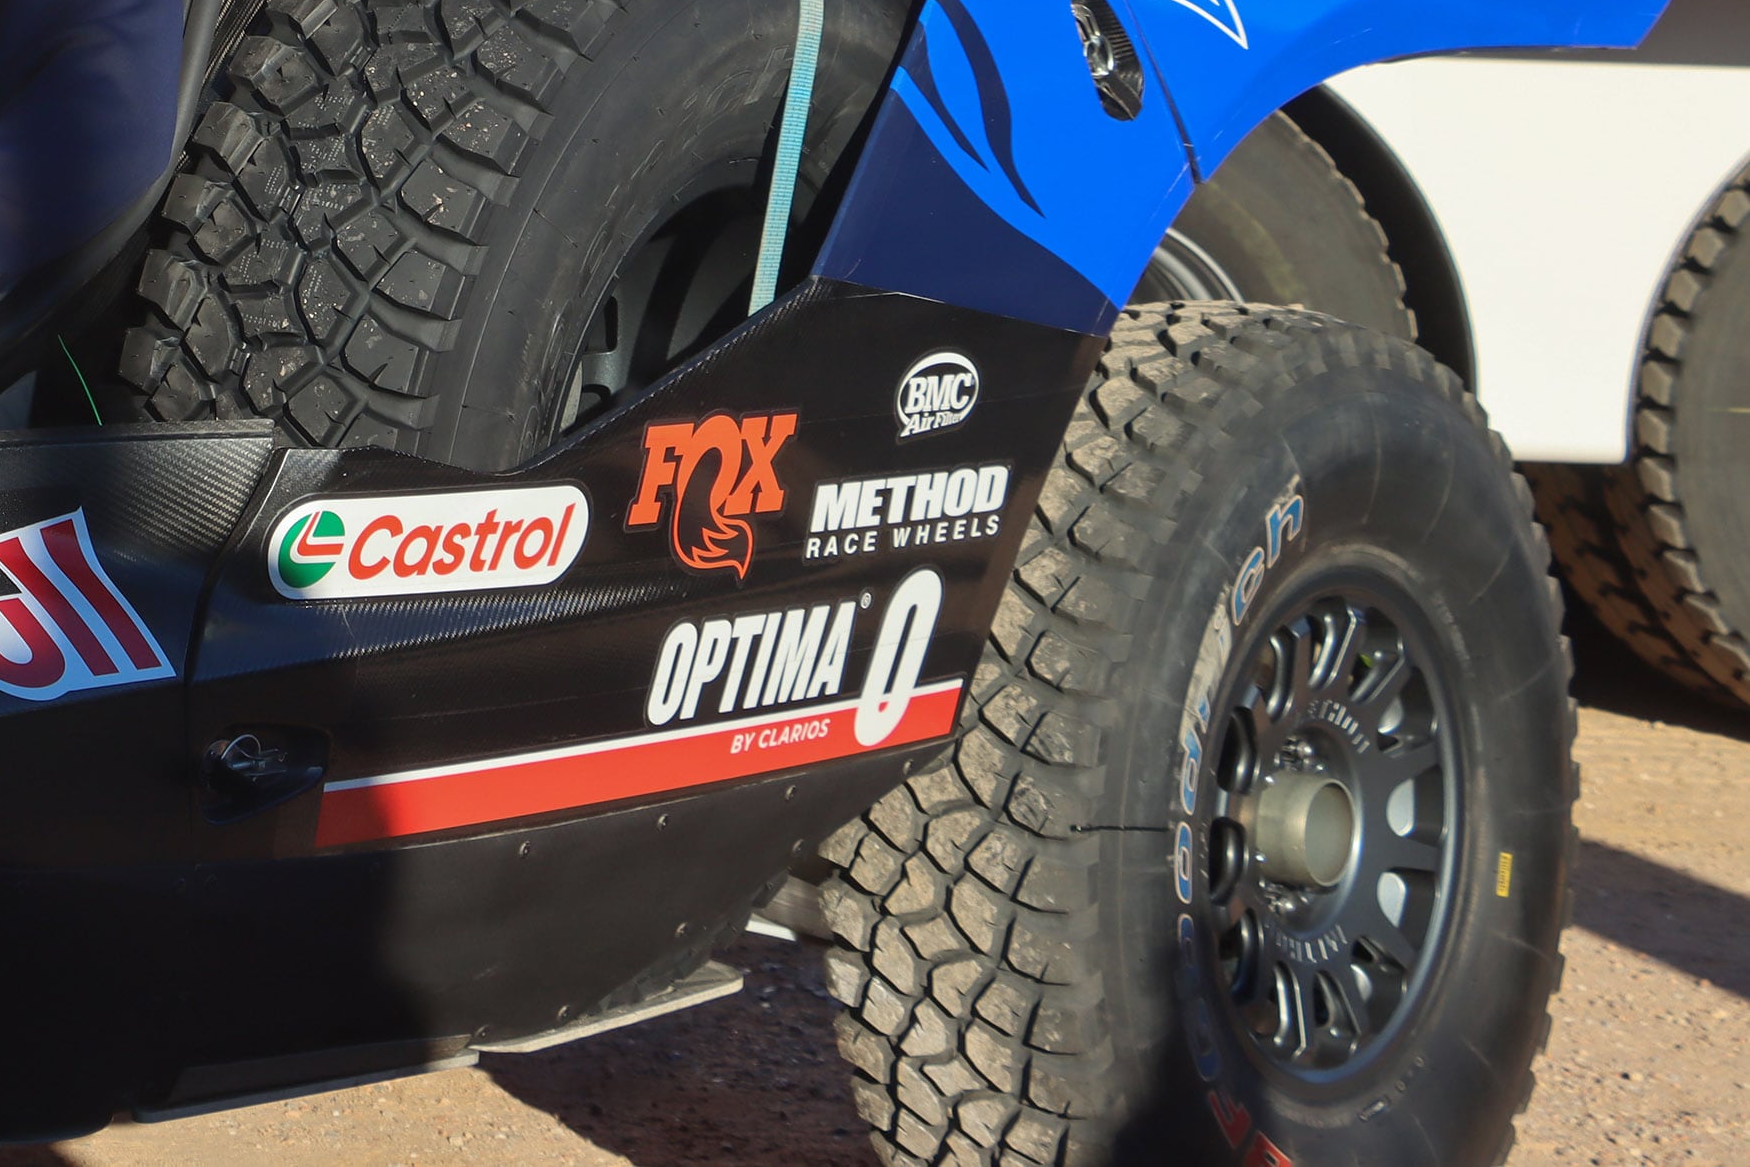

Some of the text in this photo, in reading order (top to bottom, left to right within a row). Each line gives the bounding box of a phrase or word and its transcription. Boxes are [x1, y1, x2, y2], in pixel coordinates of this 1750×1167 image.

[904, 373, 972, 414] BMC
[900, 413, 935, 437] Air
[628, 414, 797, 580] FOX
[810, 465, 1008, 533] METHOD
[348, 502, 576, 580] Castrol
[805, 514, 1000, 558] RACE WHEELS
[647, 601, 856, 726] OPTIMA
[730, 719, 830, 754] BY CLARIOS
